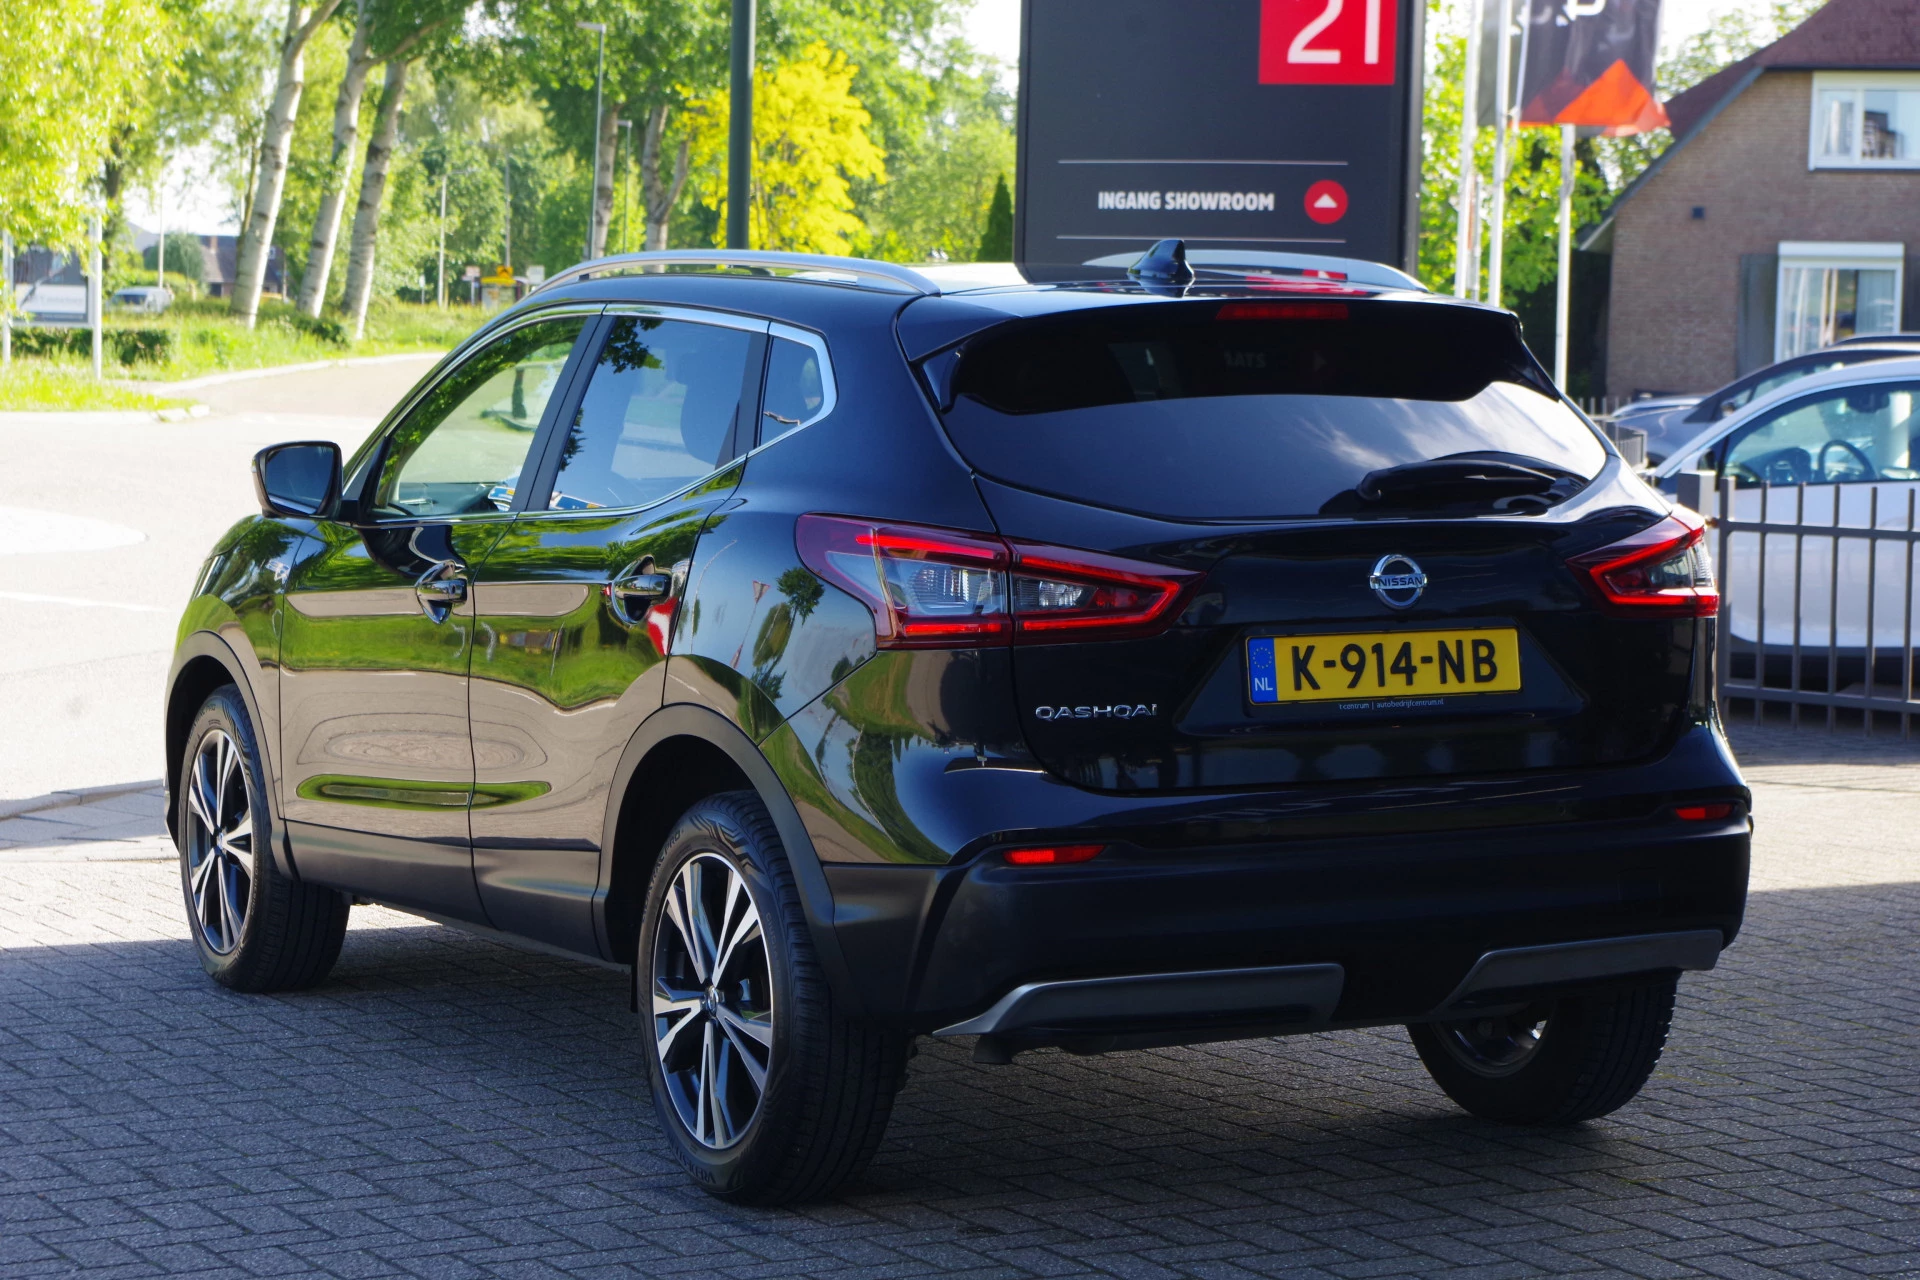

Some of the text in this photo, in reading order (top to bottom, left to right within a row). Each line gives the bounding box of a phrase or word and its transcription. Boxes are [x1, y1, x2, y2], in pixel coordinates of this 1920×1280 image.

[1287, 0, 1382, 64] 21
[1098, 190, 1275, 211] INGANG SHOWROOM
[1378, 576, 1423, 587] NISSAN
[1291, 639, 1498, 691] K-914-NB
[1254, 677, 1273, 692] NL
[1035, 703, 1158, 721] QASHQAI
